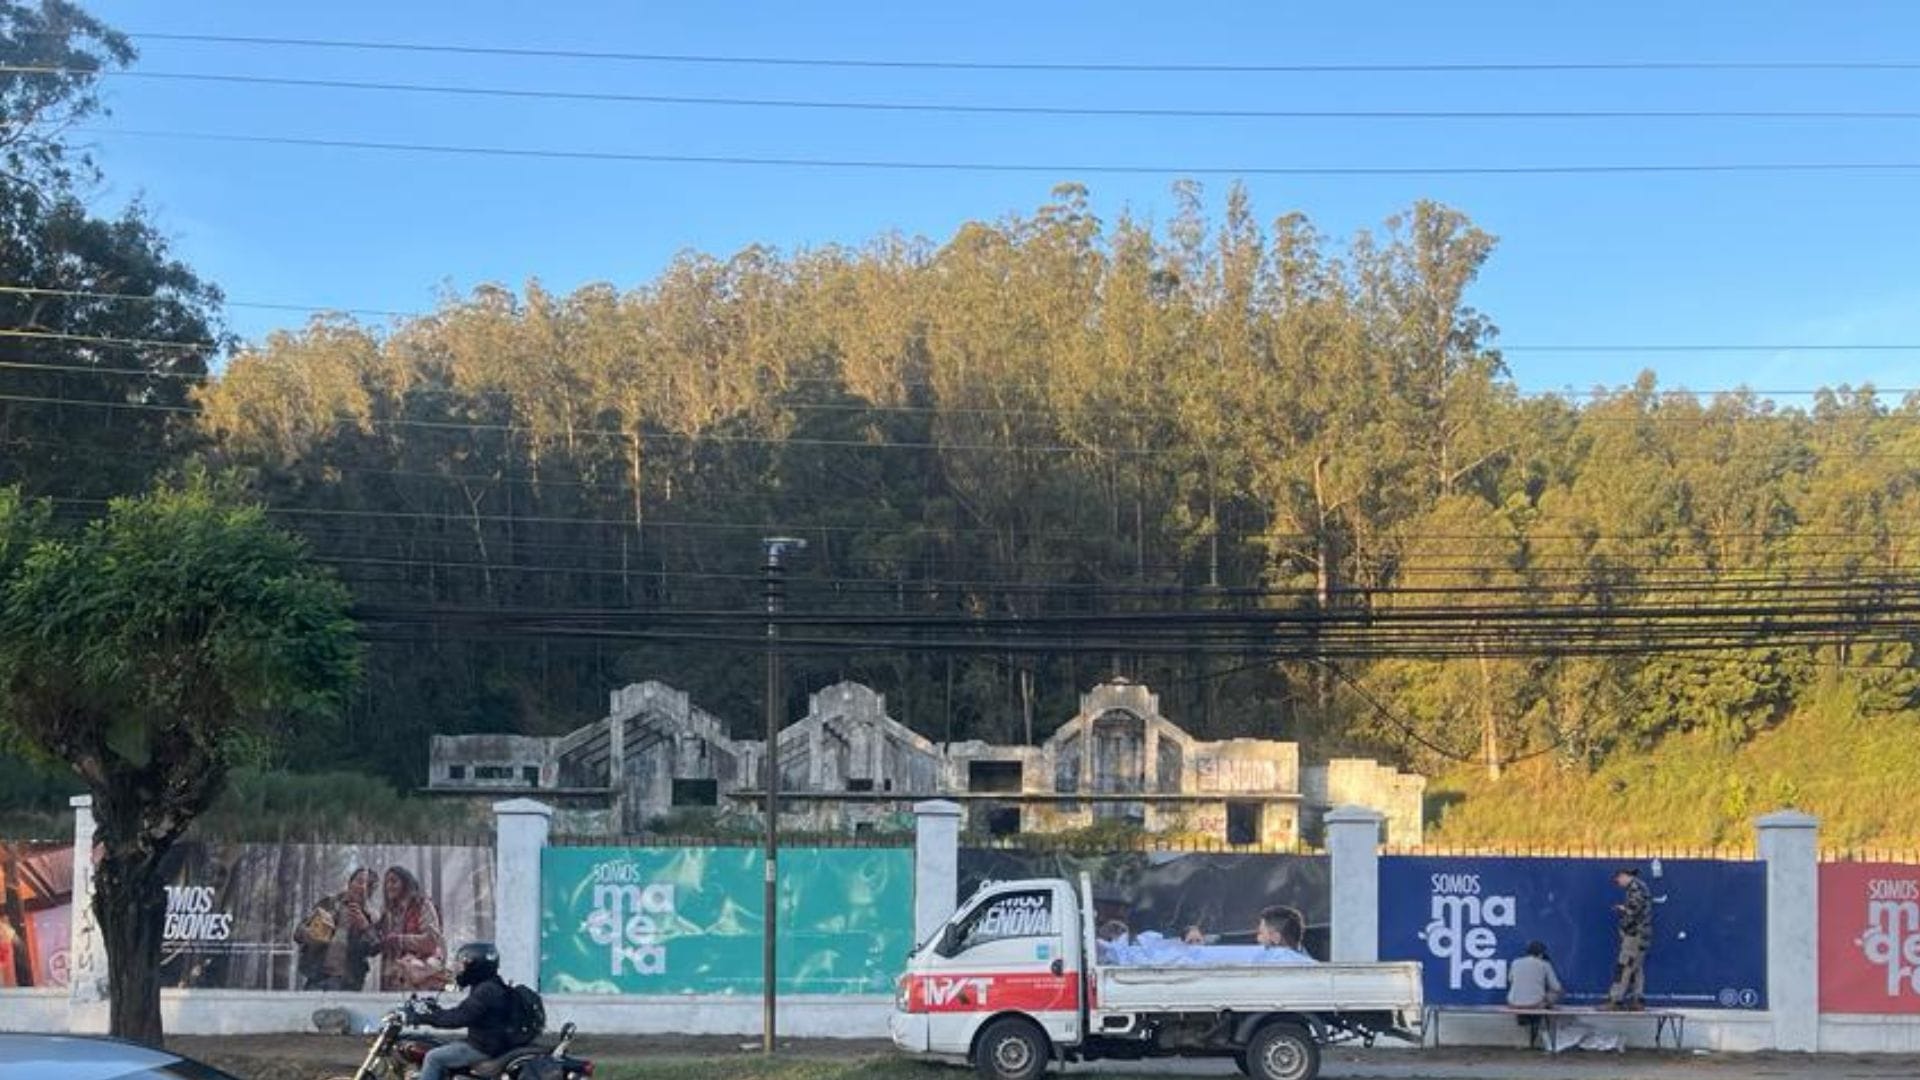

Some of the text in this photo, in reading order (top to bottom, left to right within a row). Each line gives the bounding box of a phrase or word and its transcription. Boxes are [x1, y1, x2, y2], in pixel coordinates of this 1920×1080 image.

[1431, 872, 1481, 894] SOMOS
[1867, 880, 1920, 900] SOMOS
[162, 913, 234, 940] GIONES
